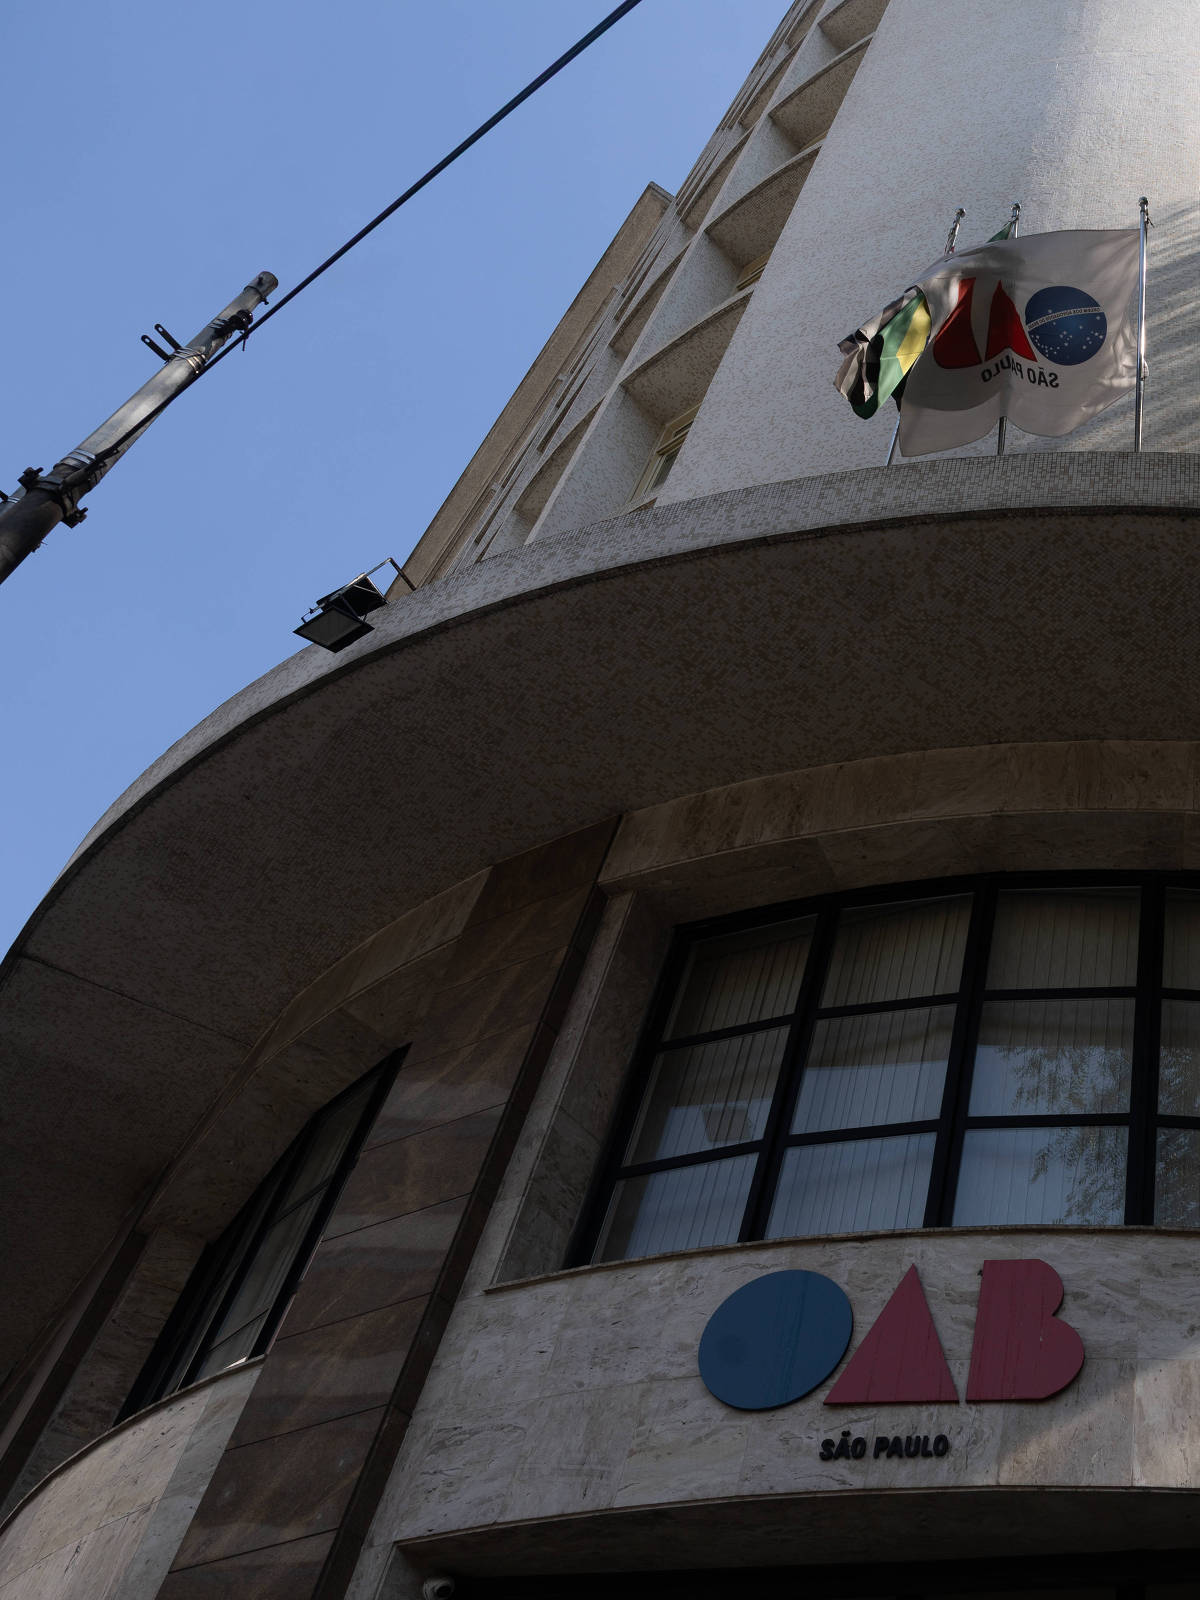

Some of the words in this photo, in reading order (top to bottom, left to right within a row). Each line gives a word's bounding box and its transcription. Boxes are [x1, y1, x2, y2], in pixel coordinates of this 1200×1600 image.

[698, 1258, 1085, 1411] OAB
[819, 1430, 867, 1461] SÃO
[873, 1434, 950, 1460] PAULO
